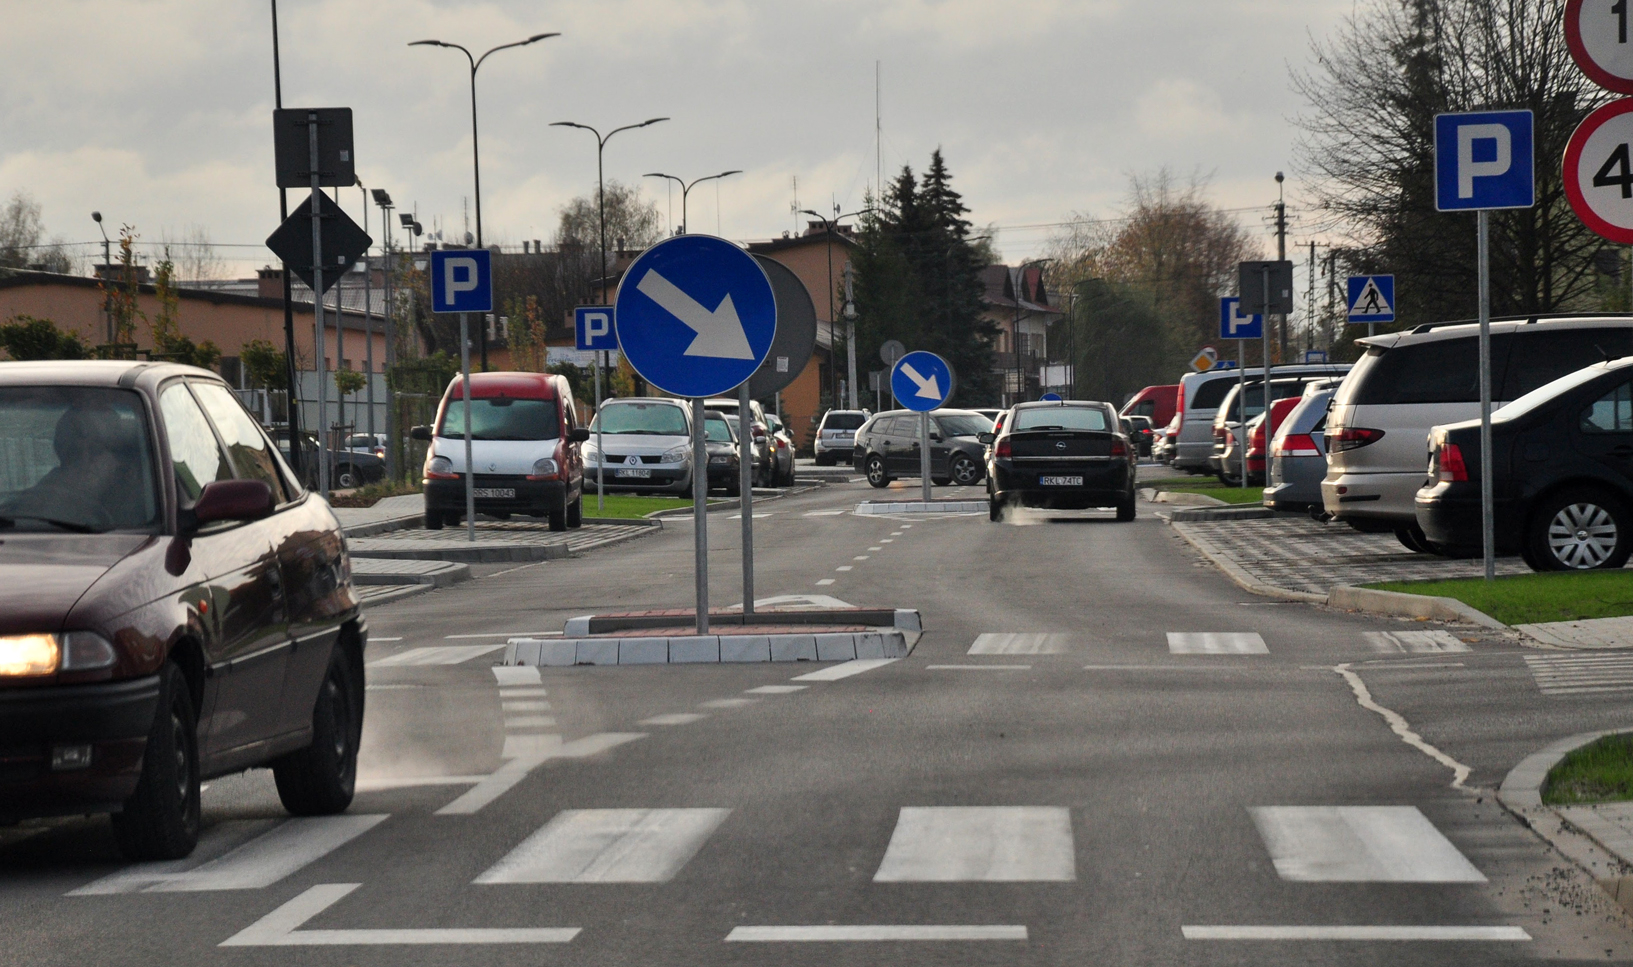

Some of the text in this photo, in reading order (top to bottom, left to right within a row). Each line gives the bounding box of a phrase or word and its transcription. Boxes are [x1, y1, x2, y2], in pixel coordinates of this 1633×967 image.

[1457, 123, 1511, 199] P
[1593, 143, 1633, 199] 4
[444, 257, 478, 305] P
[584, 312, 608, 346] P
[1229, 301, 1253, 334] P
[1044, 476, 1082, 485] RKL 74TC
